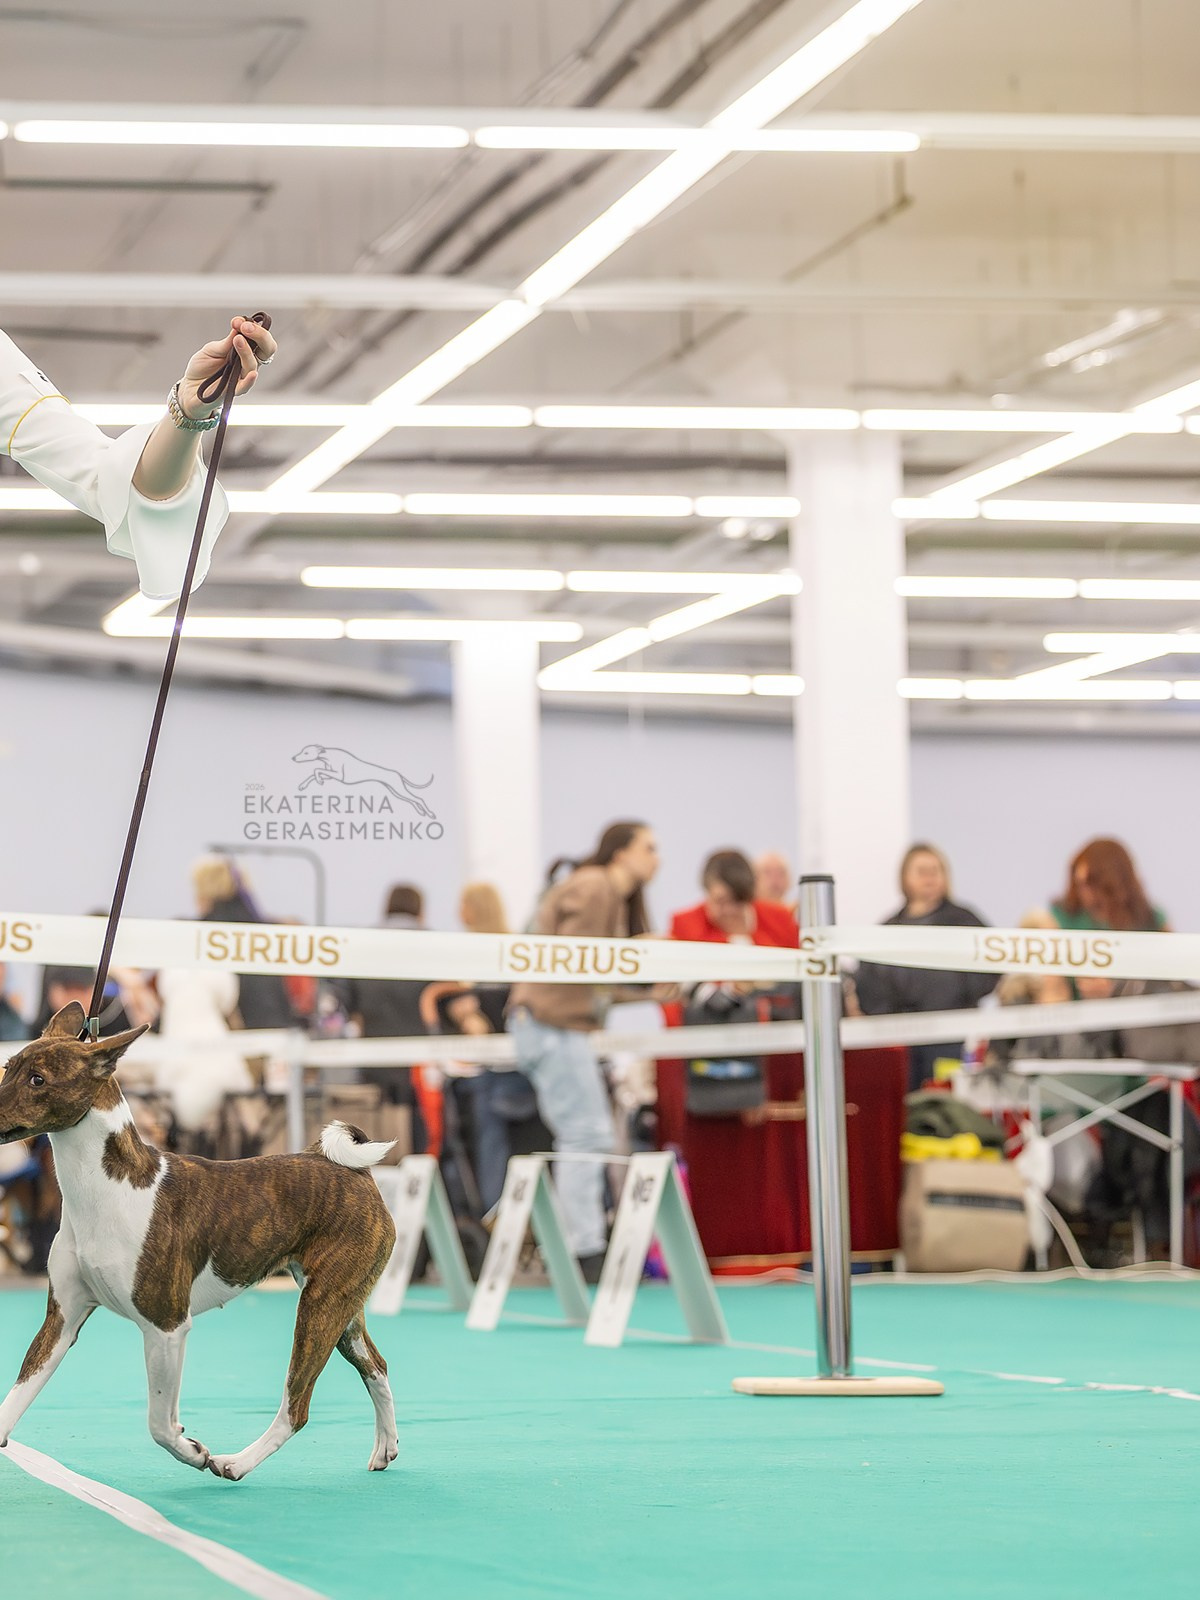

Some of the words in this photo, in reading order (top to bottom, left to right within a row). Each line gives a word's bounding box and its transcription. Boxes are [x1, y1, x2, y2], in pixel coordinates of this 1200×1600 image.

[207, 930, 340, 966] SIRIUS
[509, 942, 641, 976] SIRIUS
[984, 936, 1114, 968] SIRIUS
